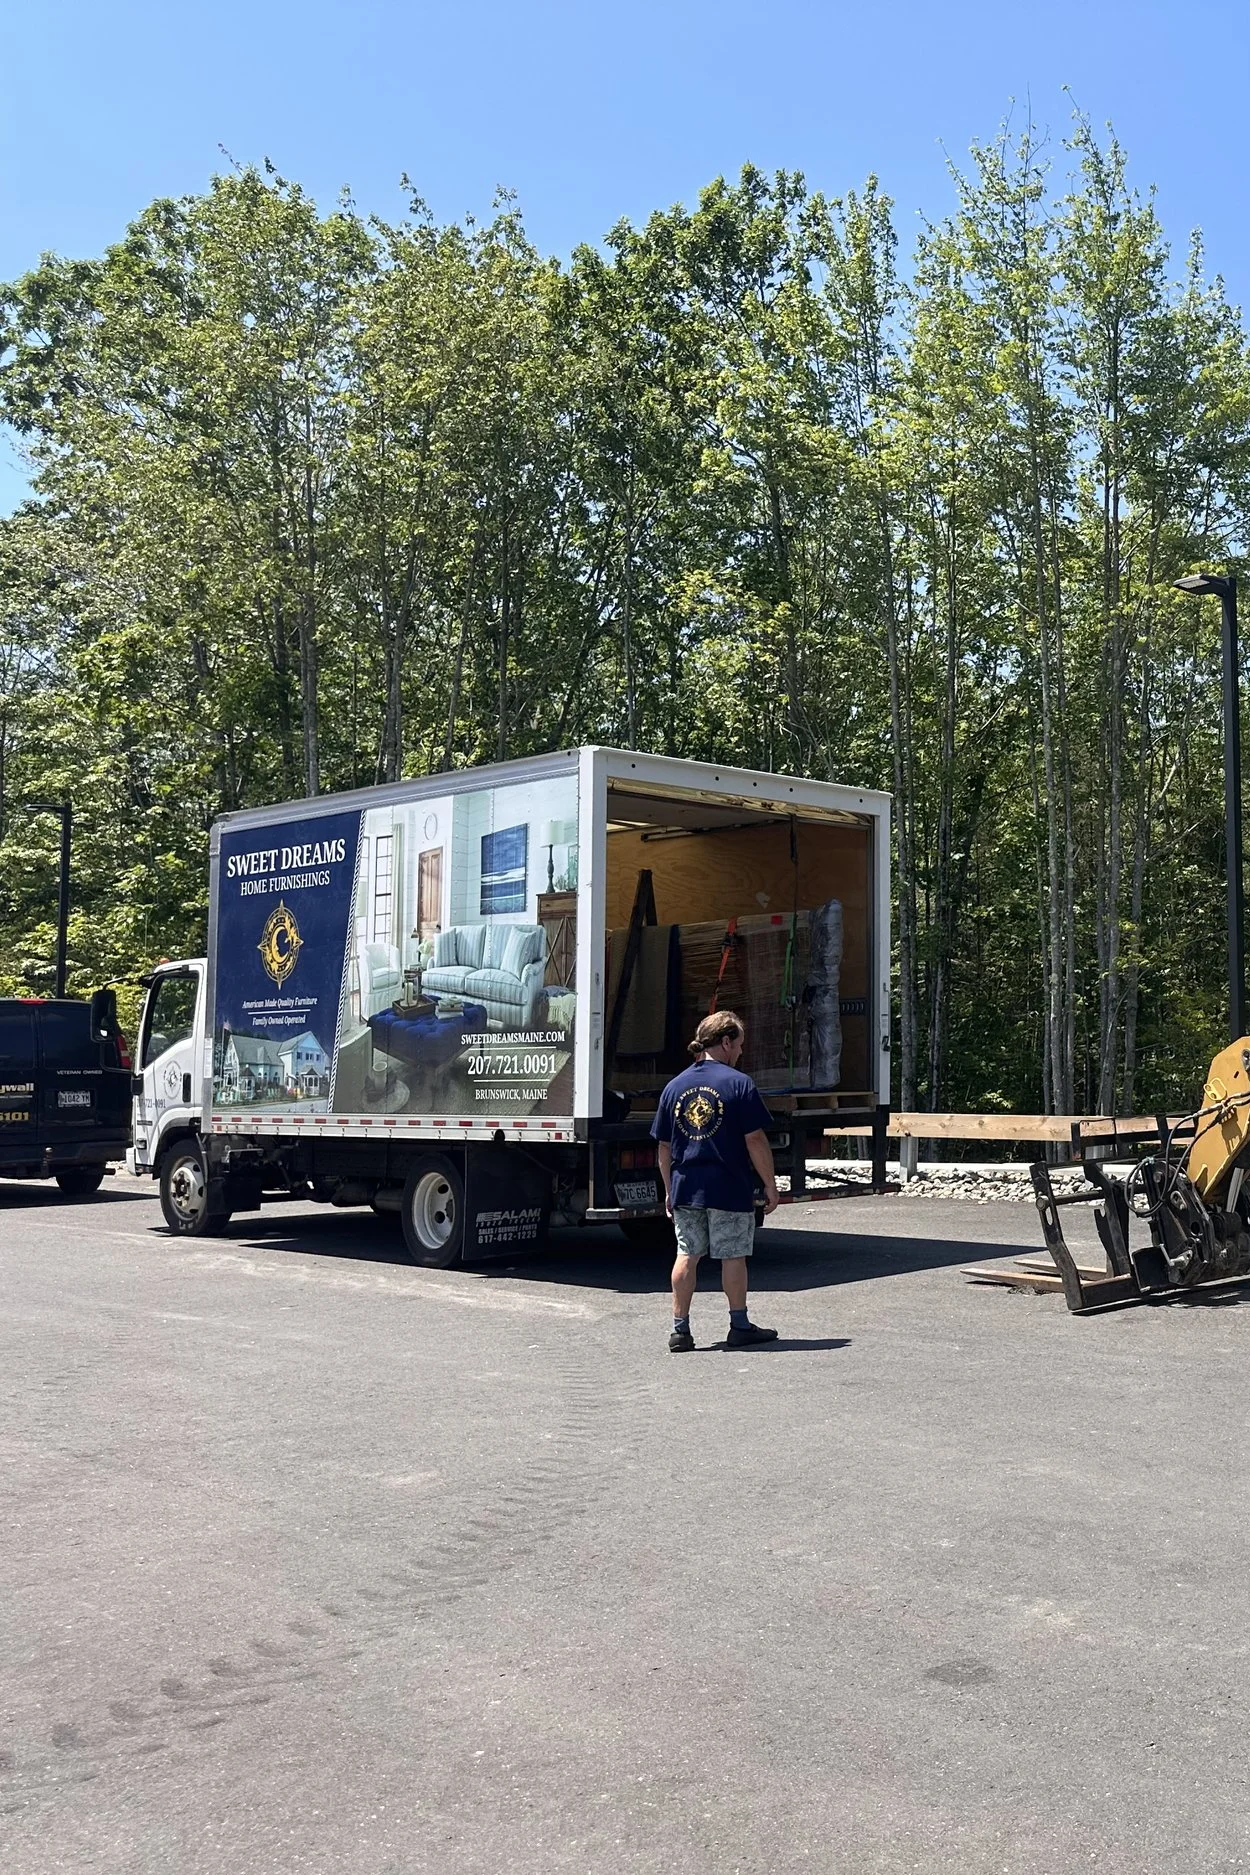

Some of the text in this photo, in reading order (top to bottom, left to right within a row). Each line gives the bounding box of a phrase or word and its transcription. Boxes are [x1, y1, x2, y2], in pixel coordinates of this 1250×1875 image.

[227, 838, 346, 878] SWEET DREAMS
[240, 870, 330, 896] HOME FURNISHINGS
[241, 996, 318, 1009] American Made Quality Furniture
[252, 1014, 306, 1028] Family Owned Operated
[461, 1031, 565, 1045] SWEETDREAMSMAINE.COM
[468, 1054, 556, 1075] 207.721.0091
[475, 1088, 548, 1101] BRUNSWICK, MAINE
[679, 1086, 721, 1101] SWEET DREAMS
